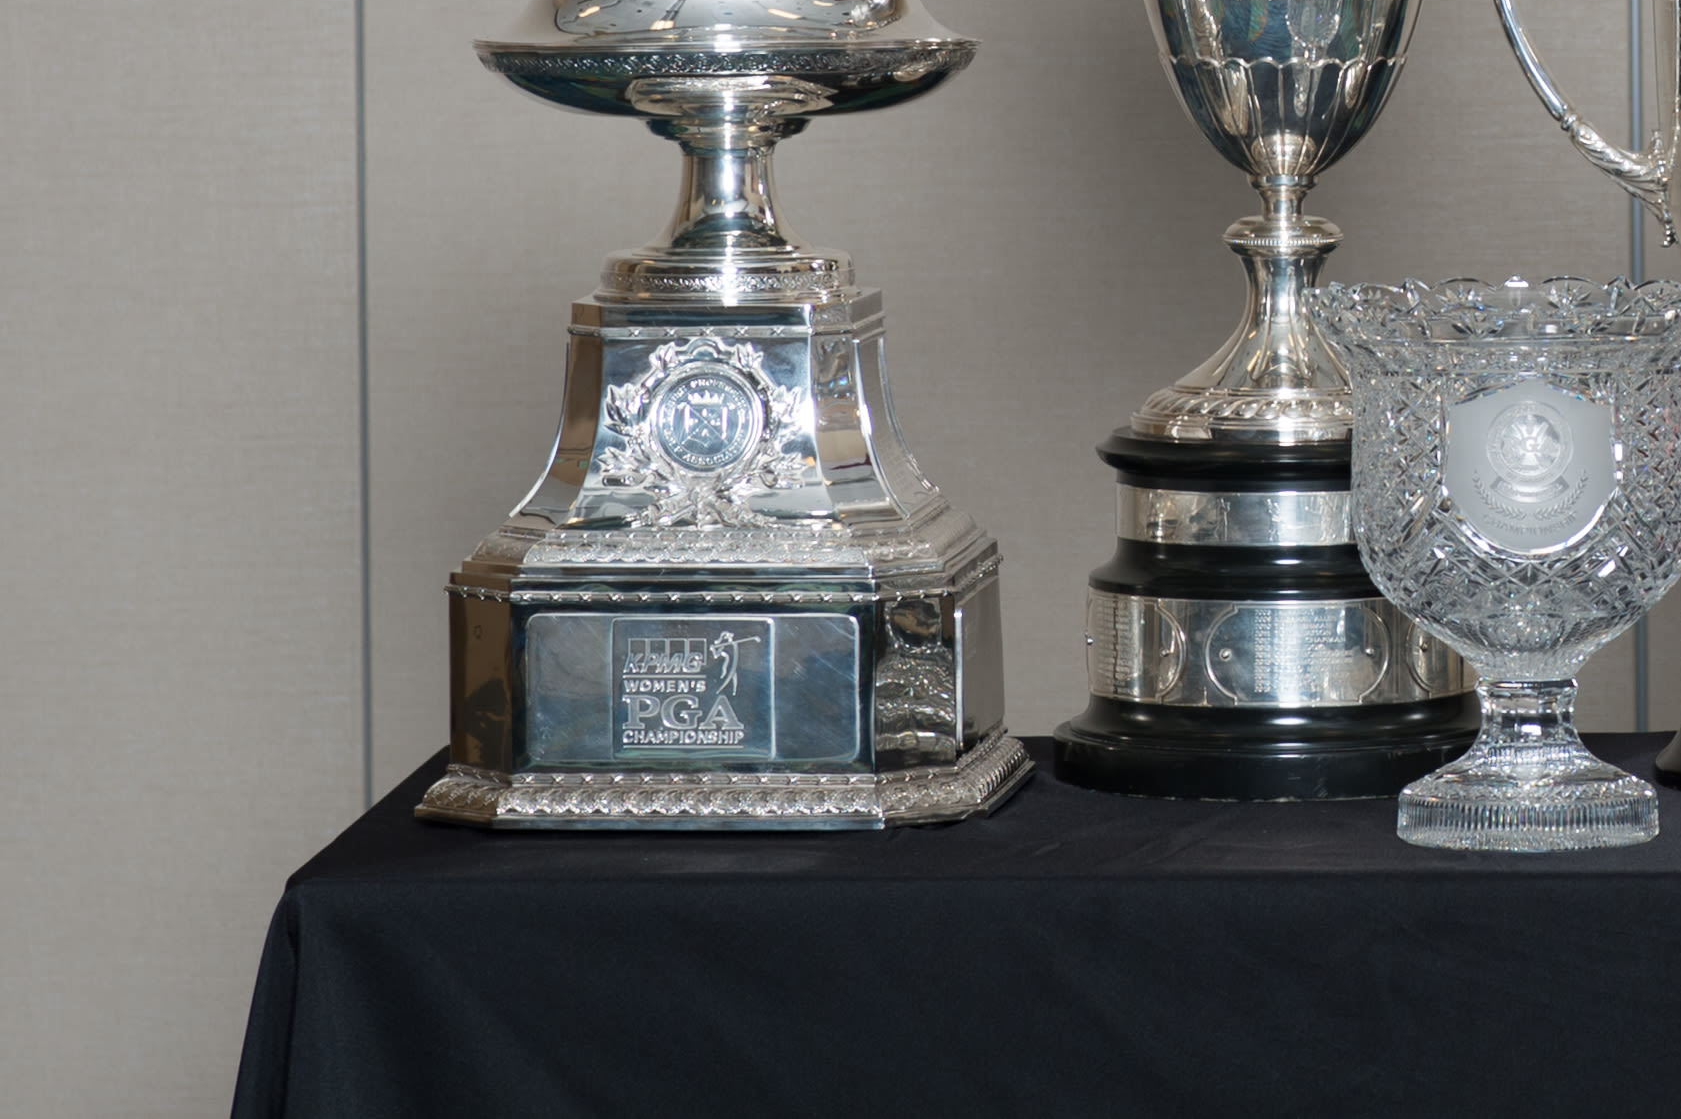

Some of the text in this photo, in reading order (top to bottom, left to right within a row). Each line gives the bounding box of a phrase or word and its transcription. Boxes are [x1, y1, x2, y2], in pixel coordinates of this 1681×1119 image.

[623, 652, 704, 673] KPMG
[623, 679, 706, 693] WOMEN'S
[622, 694, 744, 730] PGA
[622, 730, 745, 744] CHAMPIONSHIP
